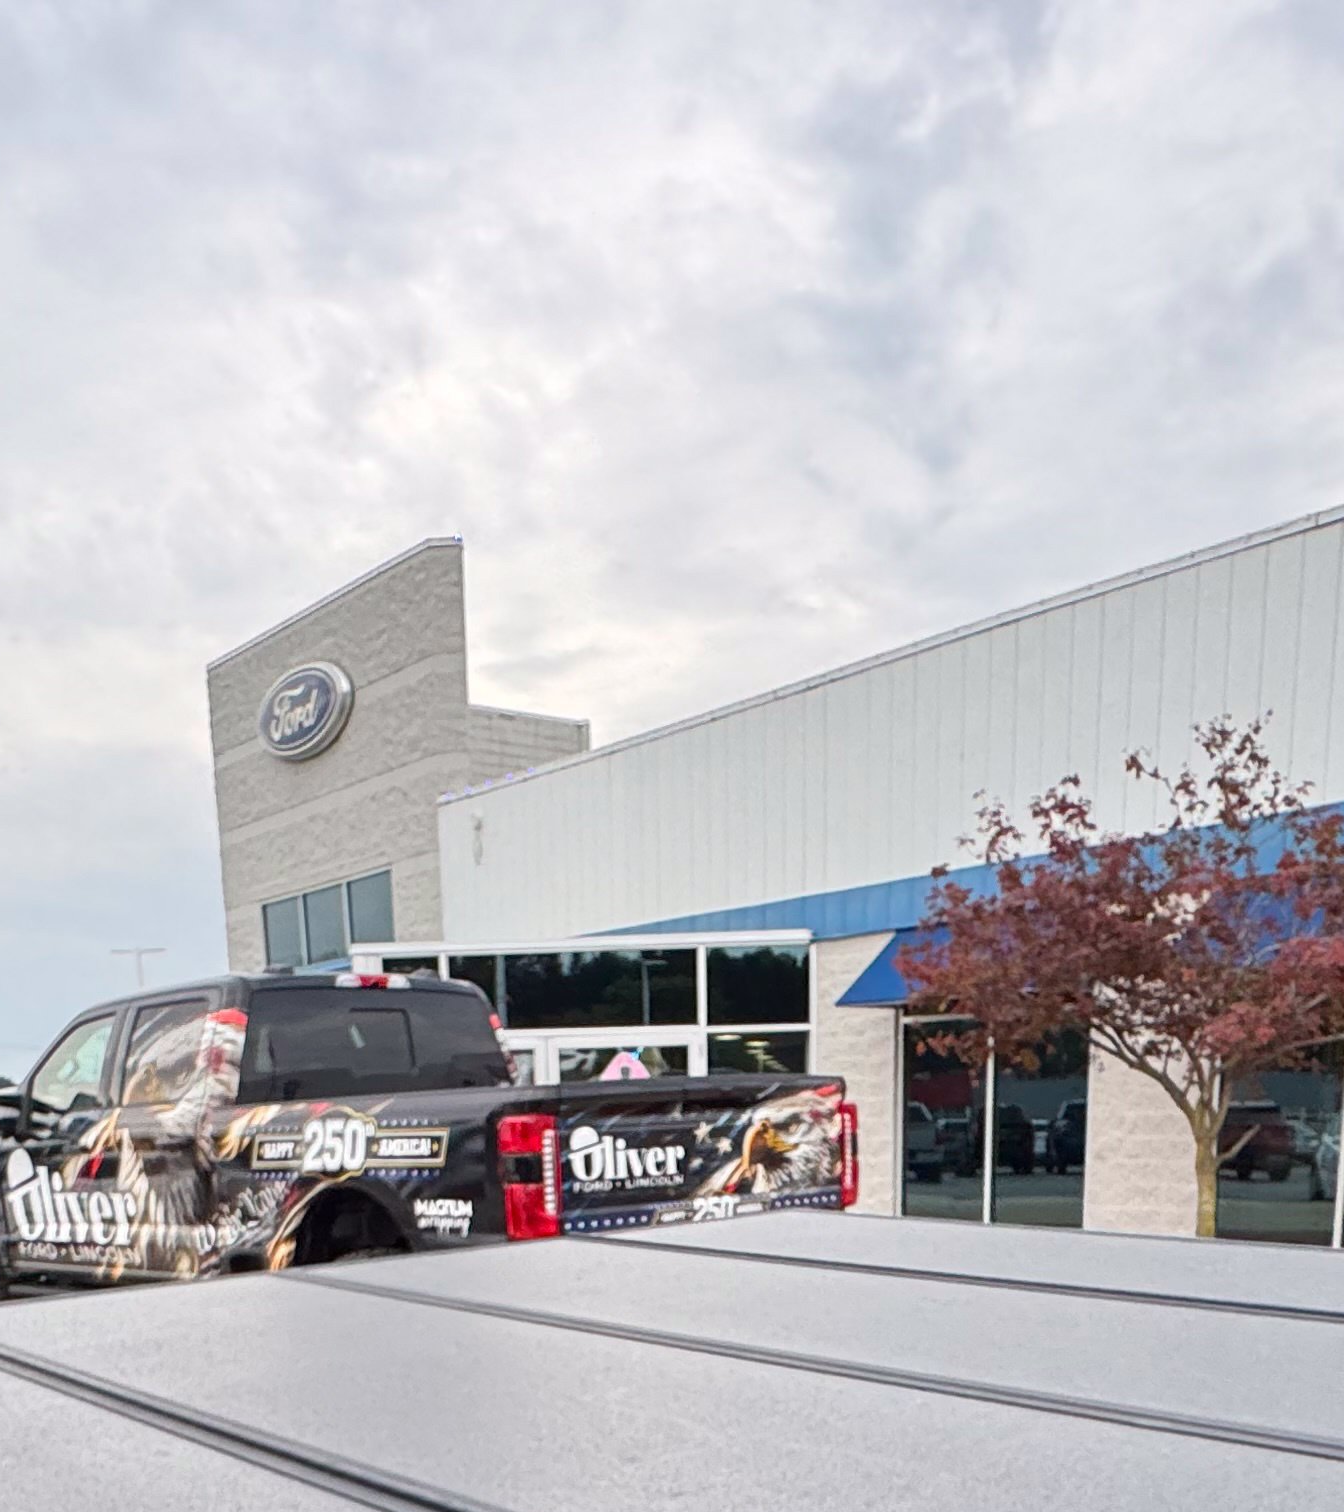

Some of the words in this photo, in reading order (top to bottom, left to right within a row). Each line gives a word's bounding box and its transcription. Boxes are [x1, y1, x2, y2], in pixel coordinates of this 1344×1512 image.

[270, 682, 318, 742] Ford
[567, 1125, 686, 1182] Oliver
[6, 1147, 137, 1246] Oliver
[572, 1180, 614, 1194] FORD
[624, 1174, 685, 1190] LINCOLN
